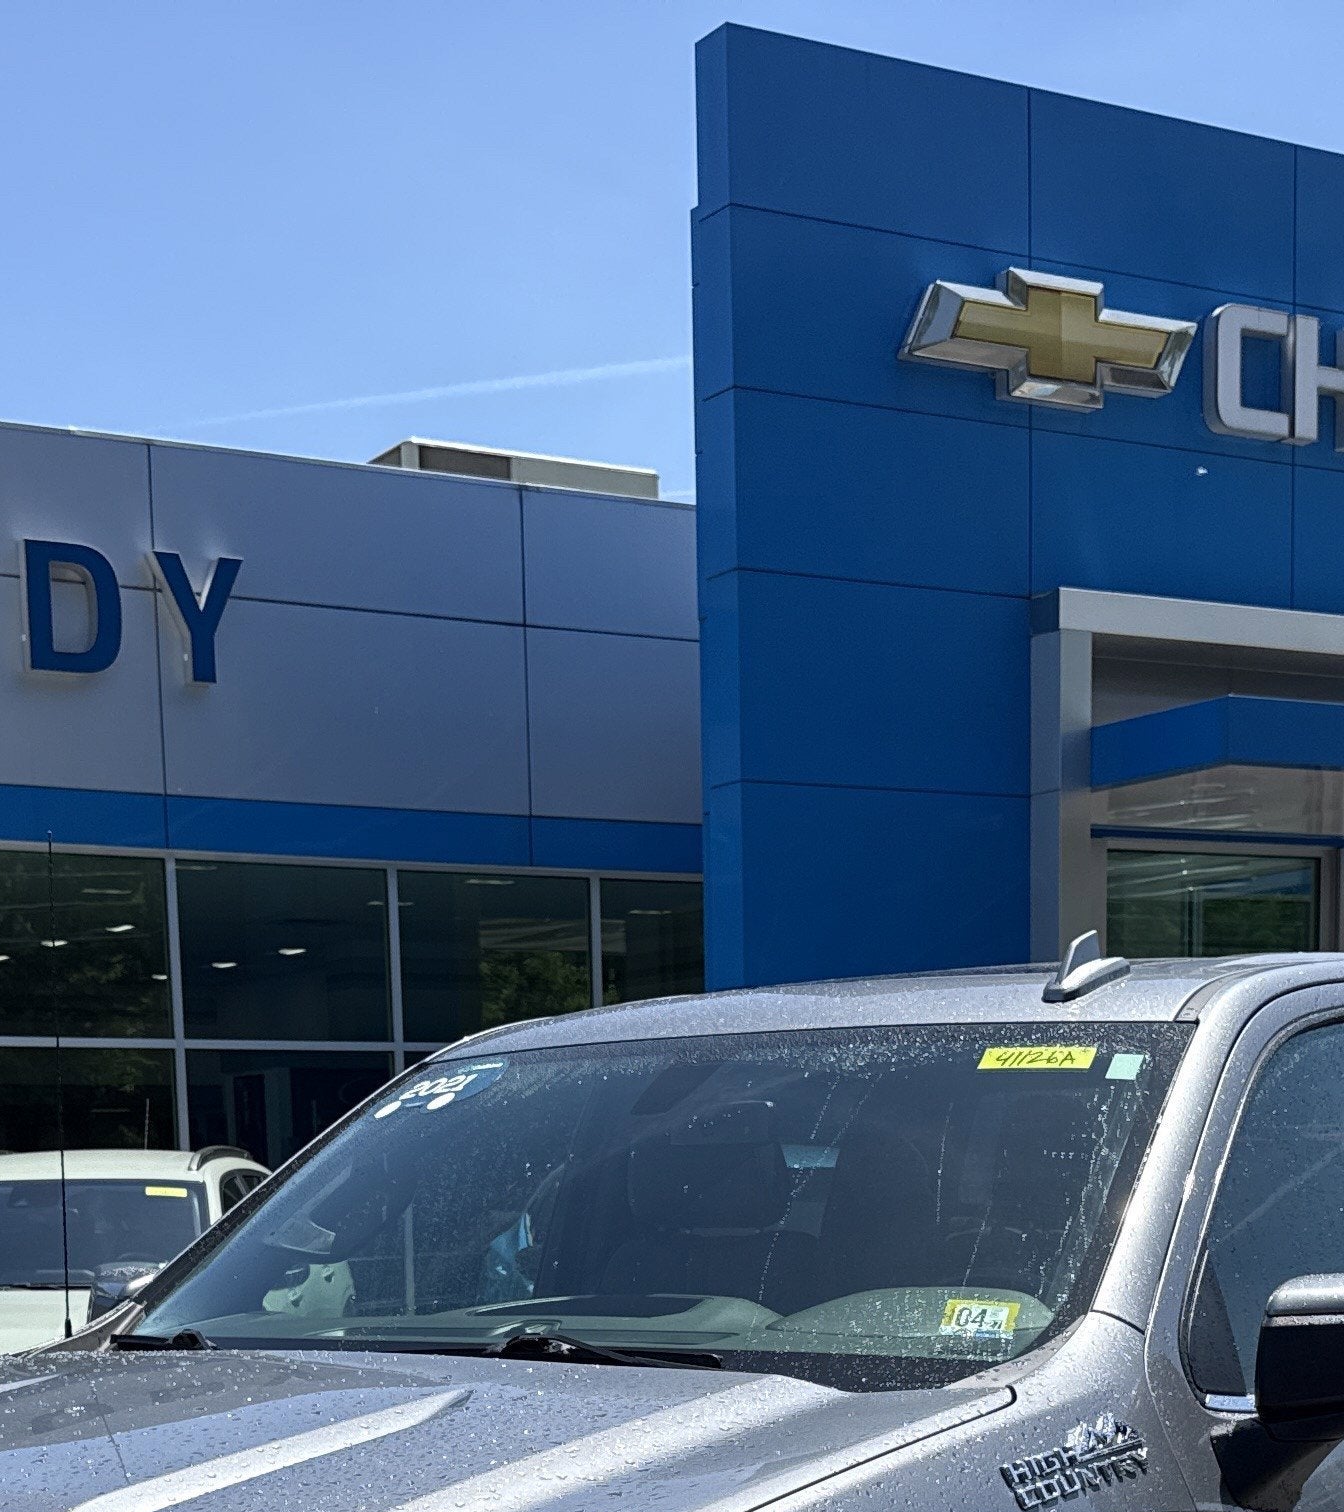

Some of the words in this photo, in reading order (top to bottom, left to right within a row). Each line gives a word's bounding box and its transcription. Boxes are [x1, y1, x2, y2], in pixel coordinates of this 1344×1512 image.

[996, 1049, 1076, 1067] 41126A
[955, 1306, 988, 1328] 04
[1001, 1448, 1081, 1484] HIGH
[1015, 1447, 1149, 1511] COUNTRY
